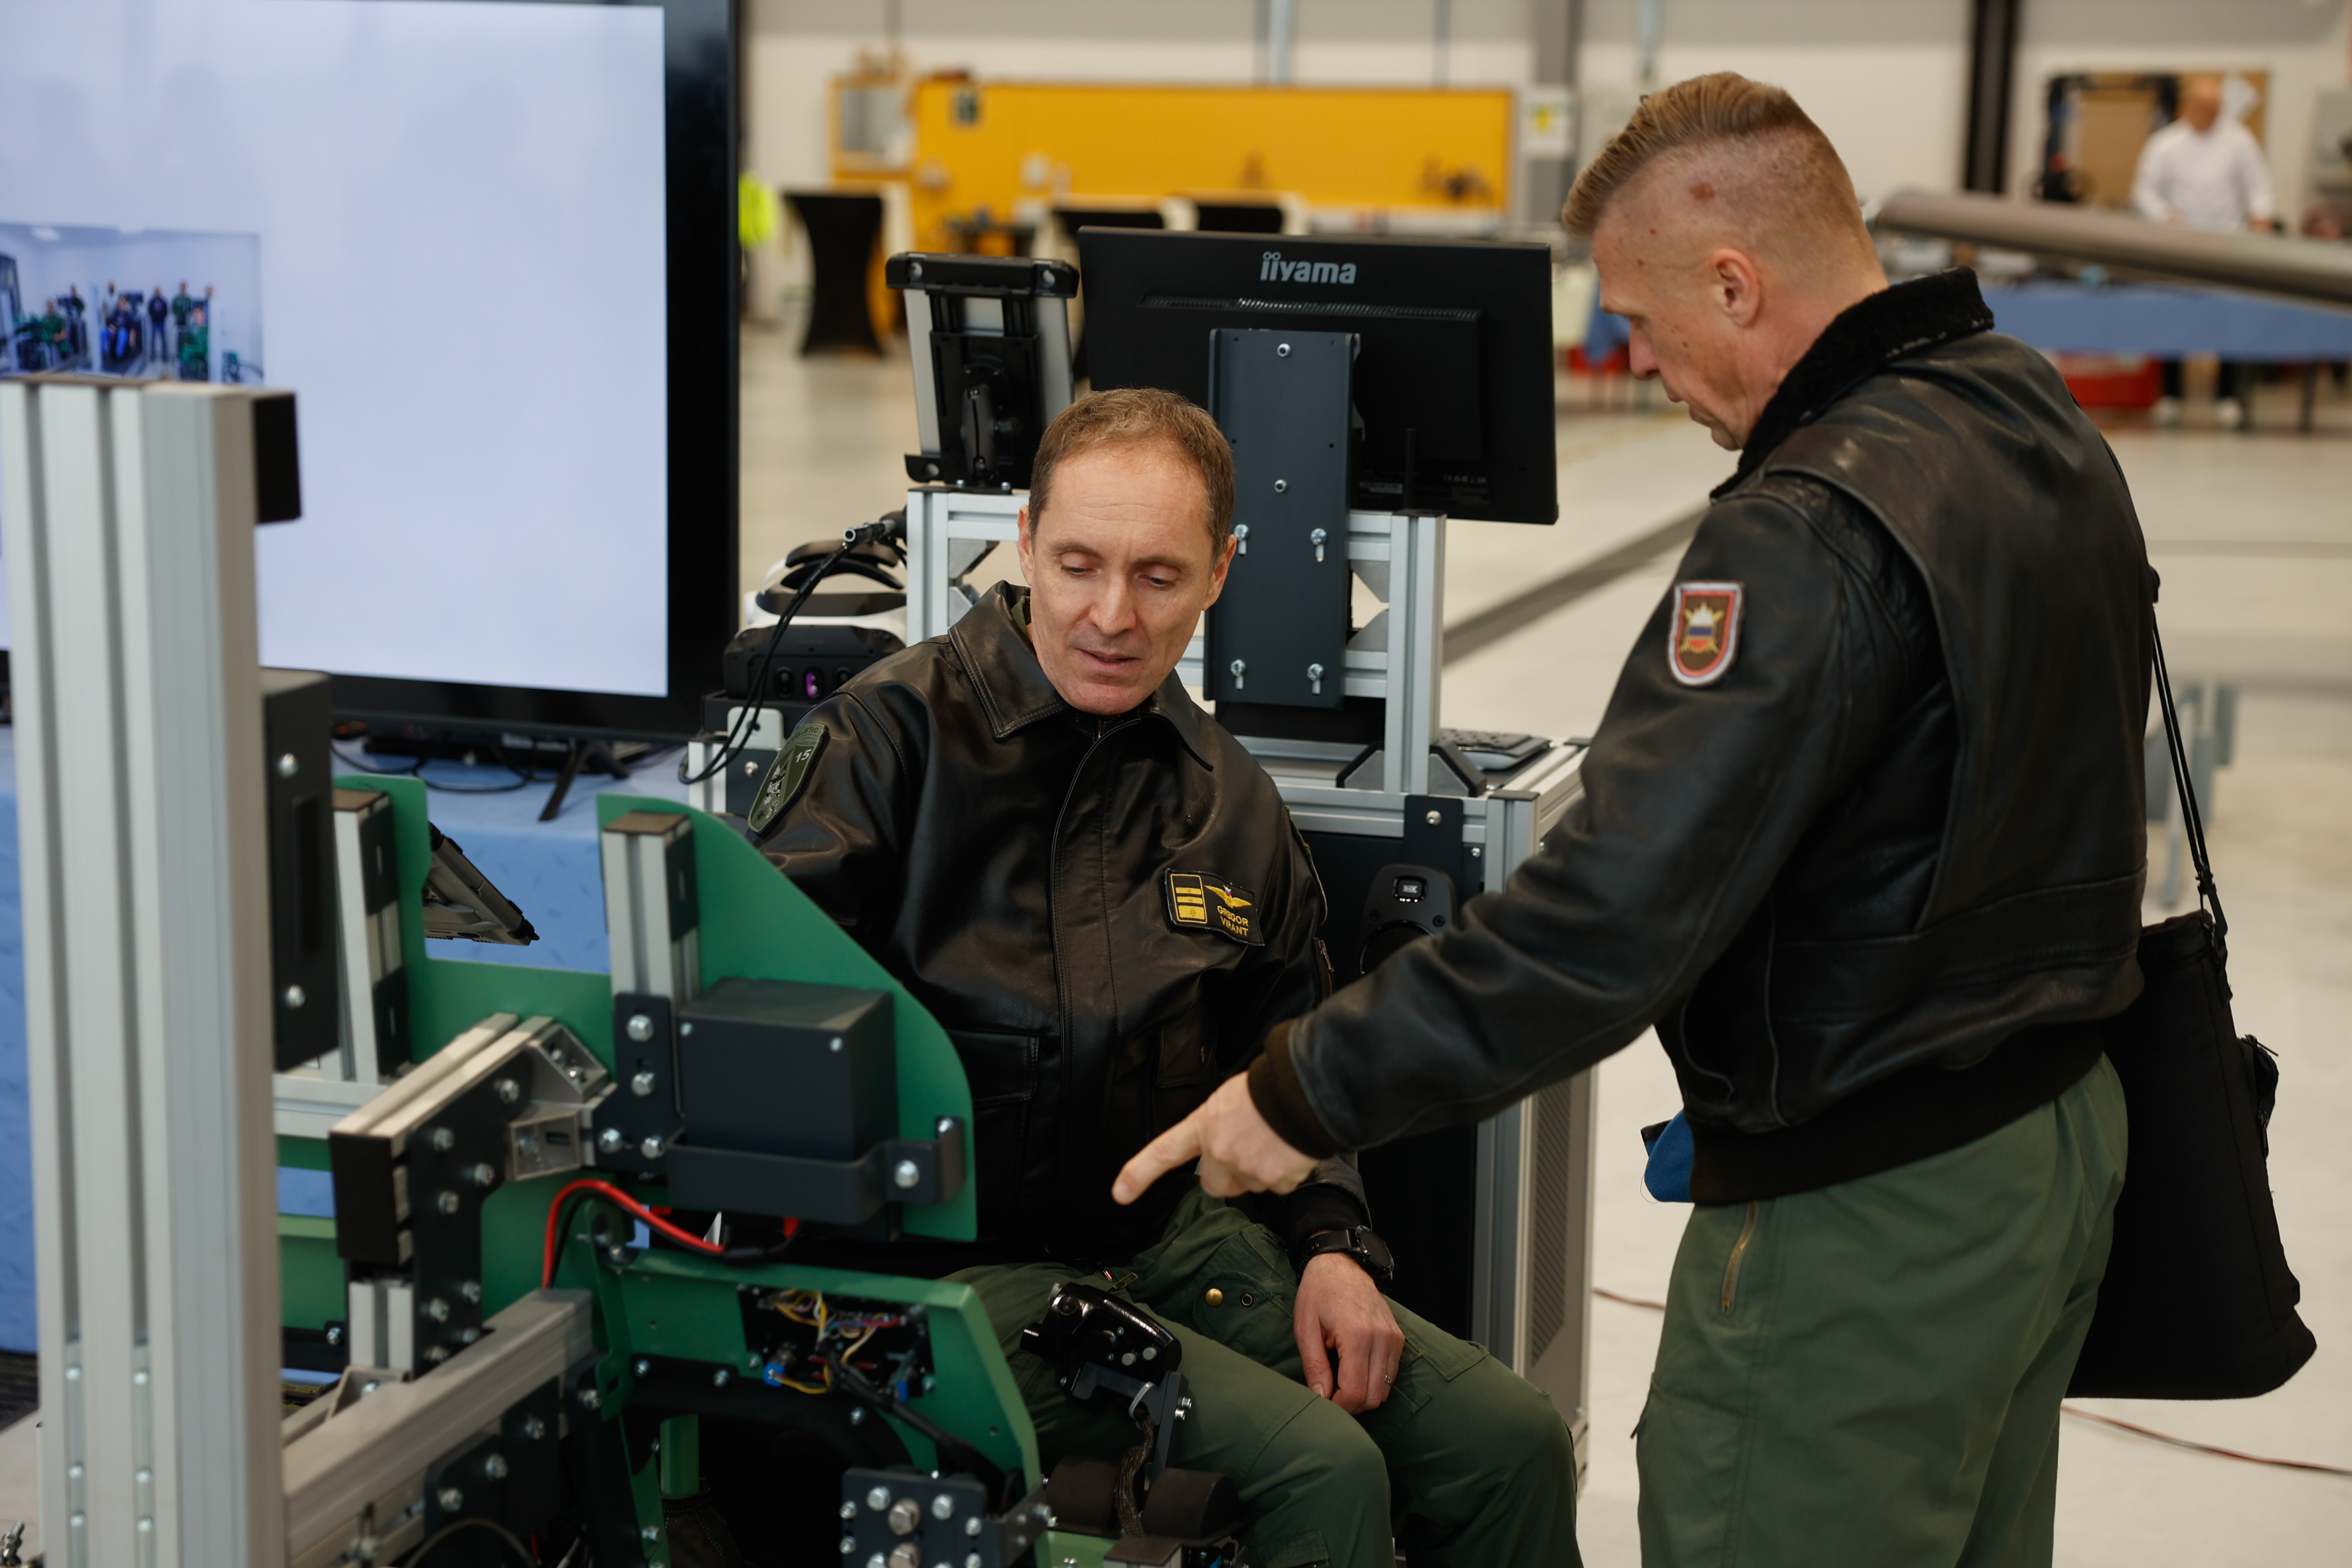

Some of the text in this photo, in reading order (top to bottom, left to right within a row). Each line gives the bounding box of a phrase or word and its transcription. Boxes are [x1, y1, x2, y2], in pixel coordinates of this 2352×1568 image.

[1260, 251, 1357, 284] iiyama
[795, 749, 812, 763] 15
[1217, 905, 1249, 927] GREGOR
[1220, 915, 1249, 936] VIRANT
